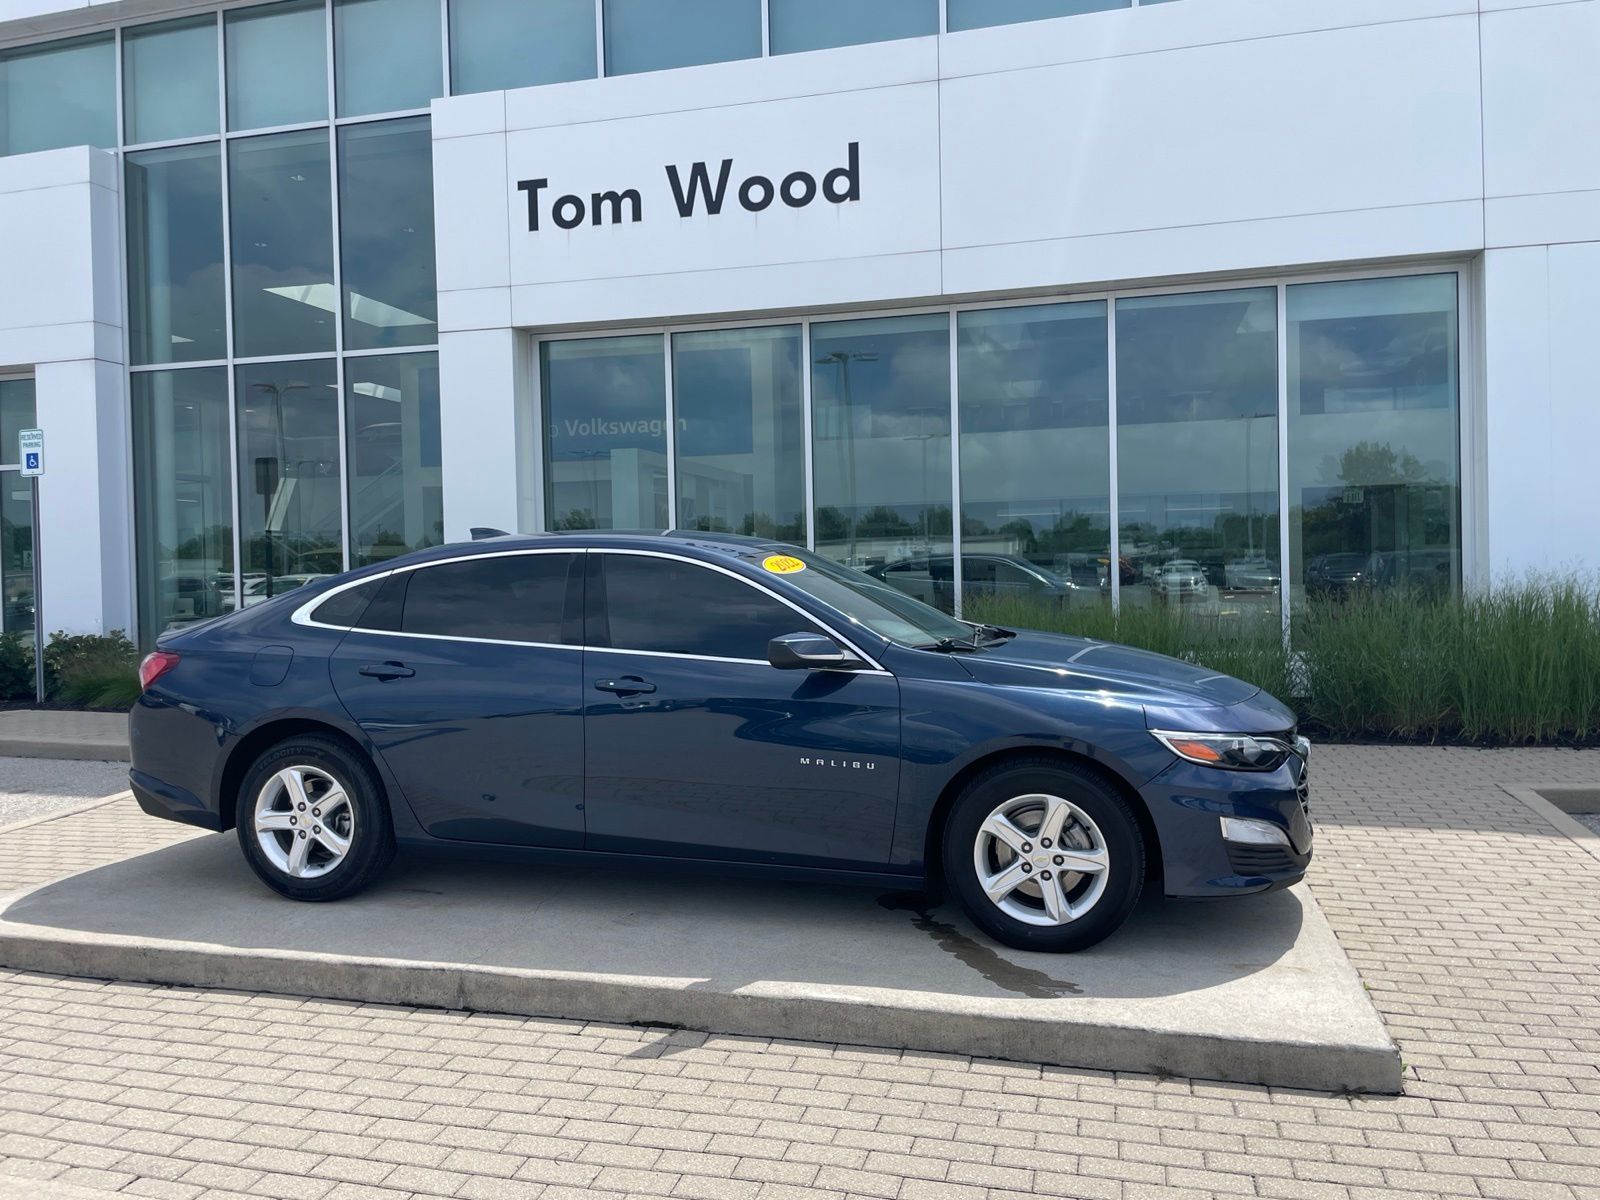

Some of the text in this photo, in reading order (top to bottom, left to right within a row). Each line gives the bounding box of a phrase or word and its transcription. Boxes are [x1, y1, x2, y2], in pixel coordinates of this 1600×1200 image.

[517, 141, 861, 232] Tom Wood
[800, 758, 875, 770] MALIBU
